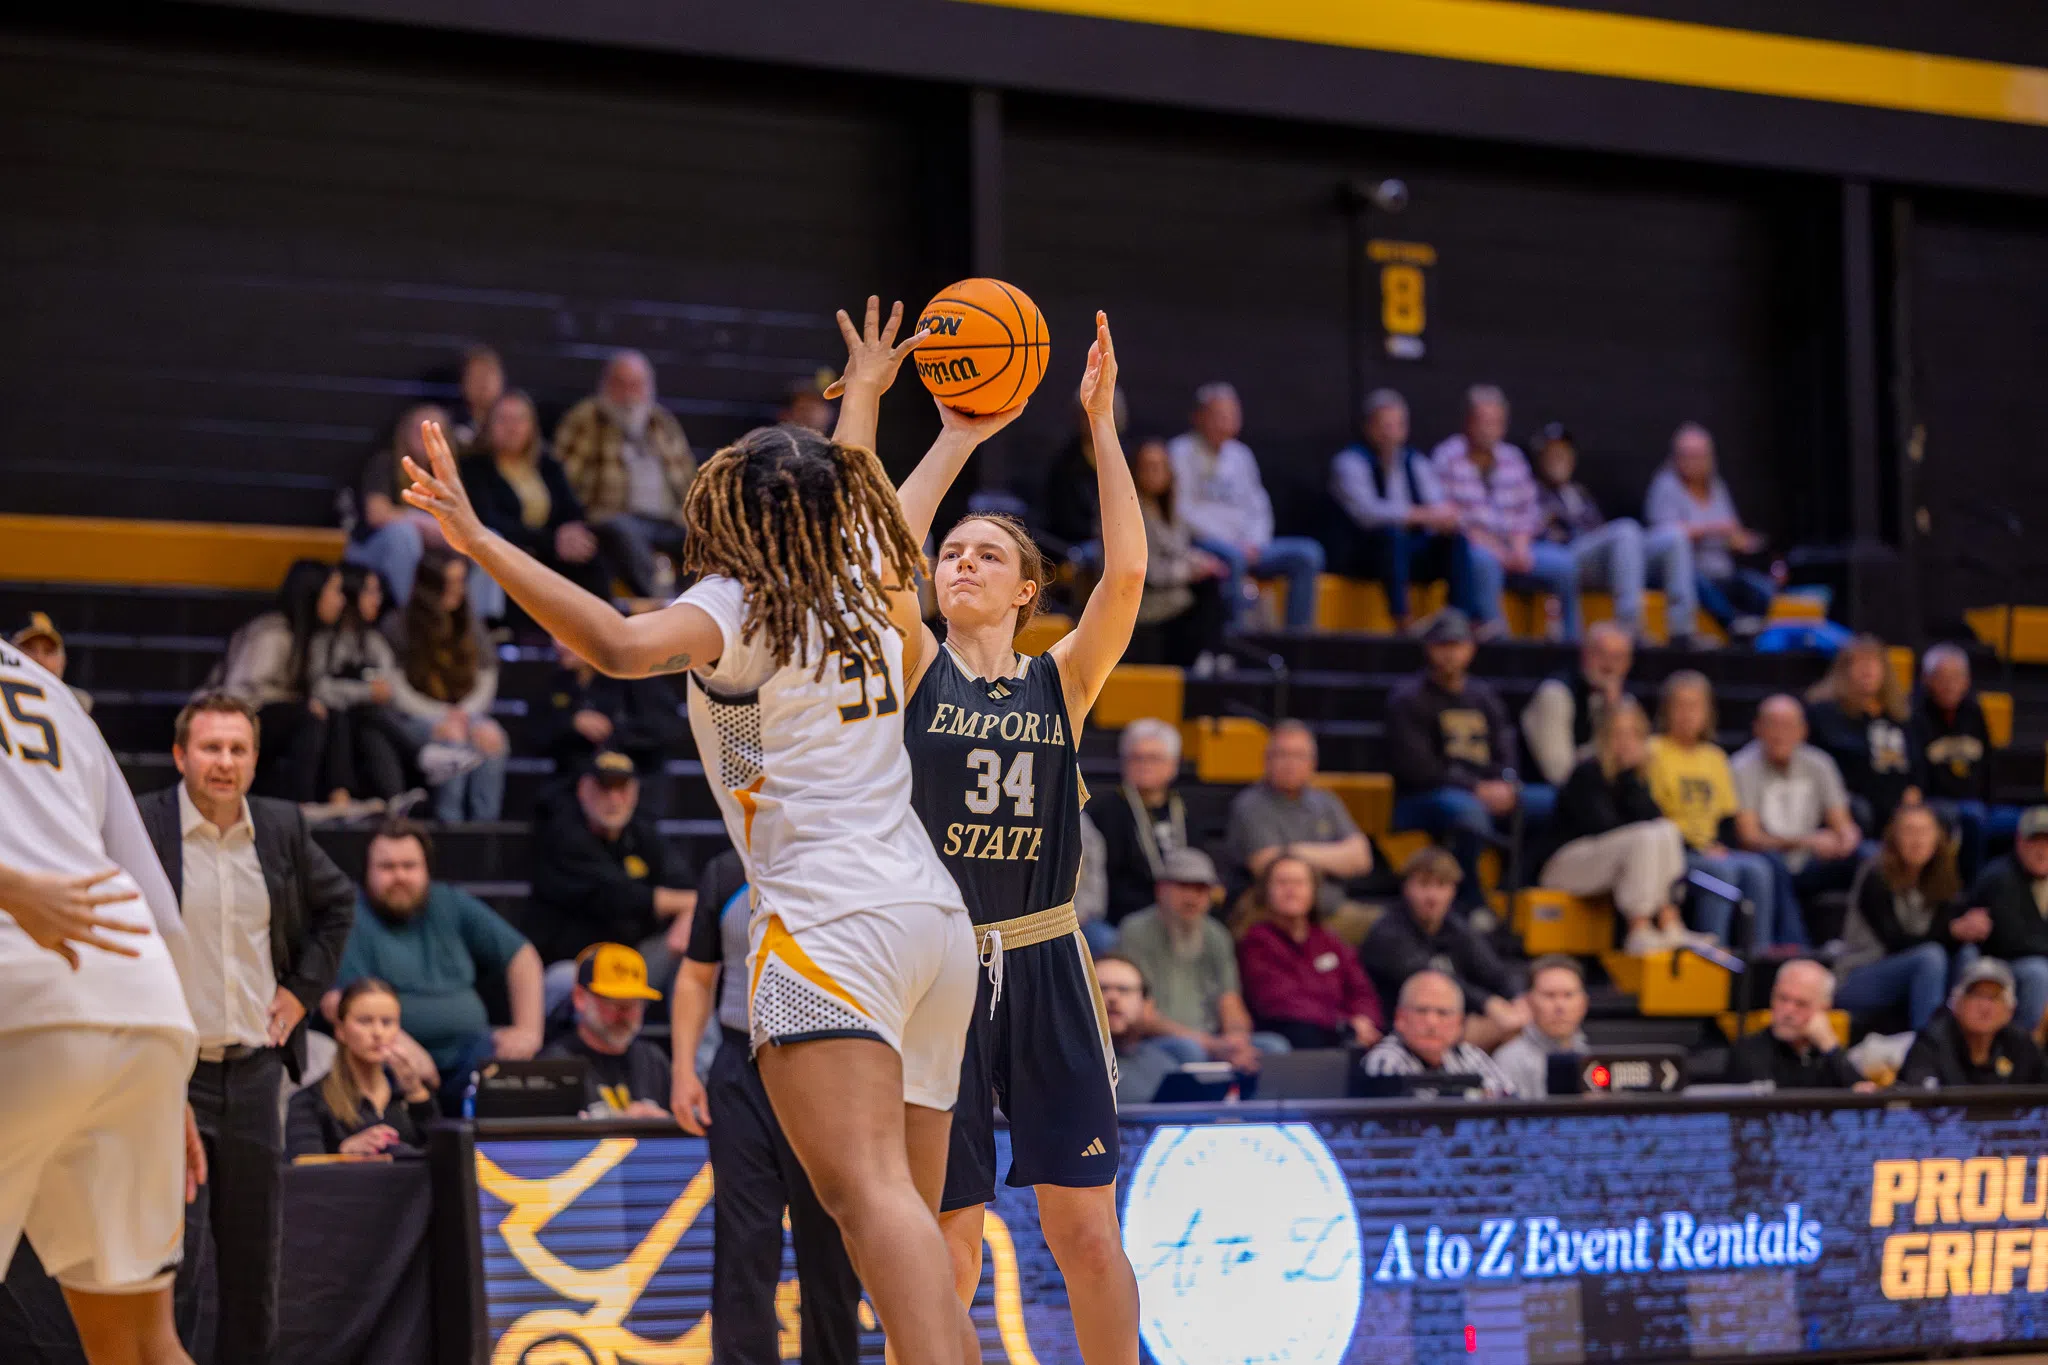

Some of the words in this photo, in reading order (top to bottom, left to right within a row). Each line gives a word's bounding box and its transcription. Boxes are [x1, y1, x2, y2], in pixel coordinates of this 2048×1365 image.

[916, 314, 963, 336] NCA
[917, 356, 981, 385] Wilso
[0, 676, 62, 771] 5
[927, 702, 1065, 746] EMPORIA
[964, 747, 1035, 817] 34
[1869, 1155, 2048, 1228] PROU
[1373, 1223, 1417, 1282] A
[1425, 1224, 1473, 1280] to
[1476, 1217, 1517, 1279] Z
[1520, 1215, 1654, 1276] Event
[1657, 1202, 1823, 1272] Rentals
